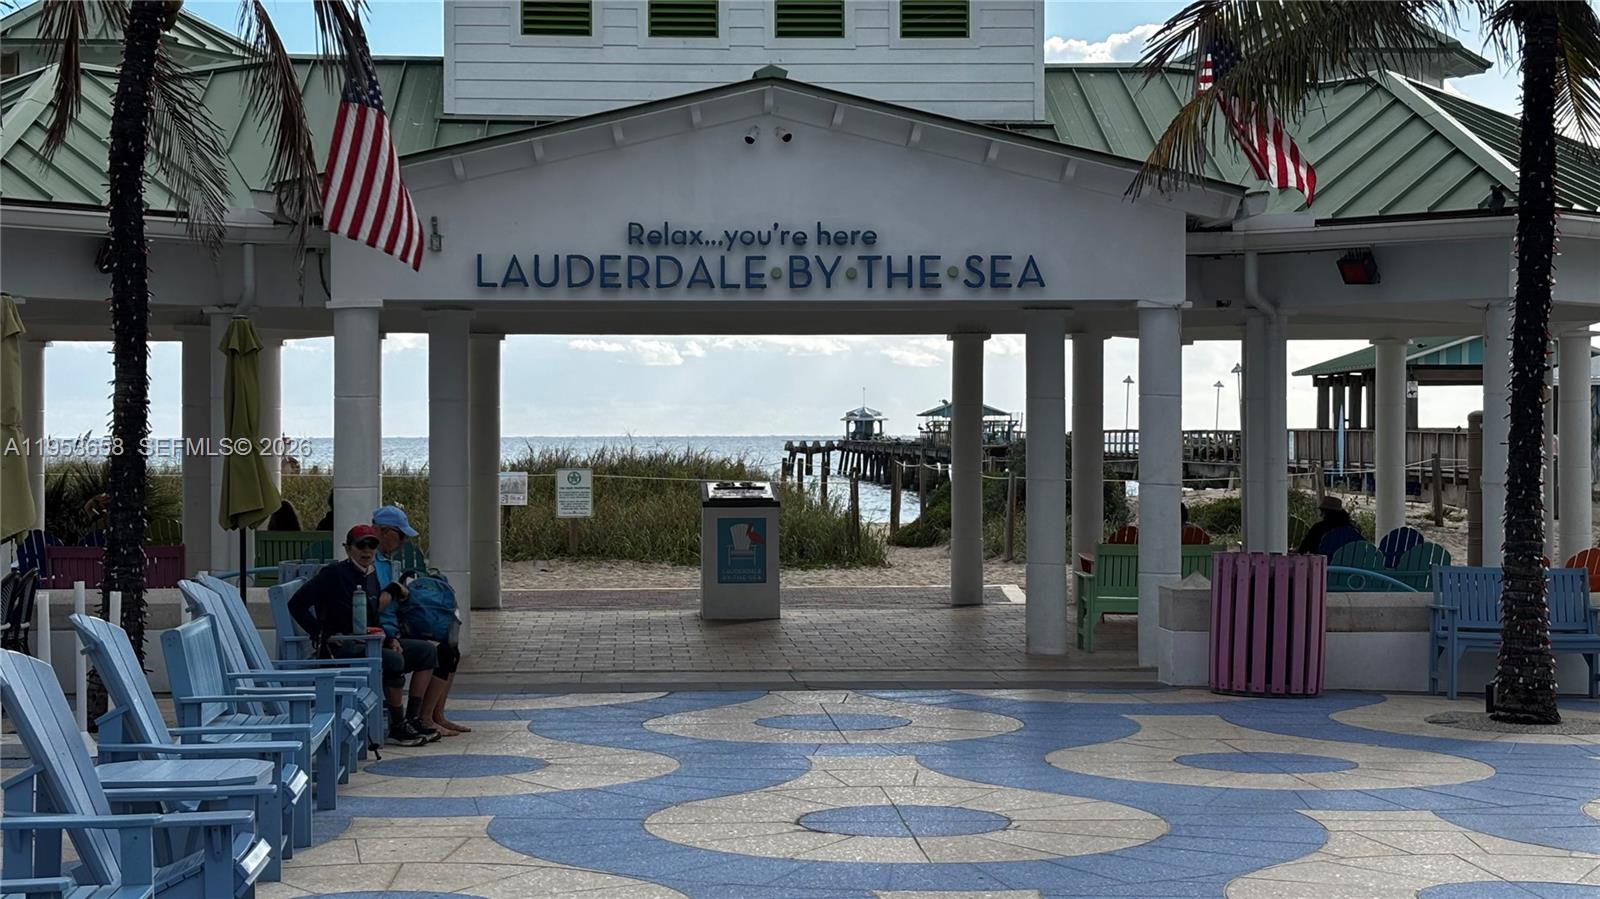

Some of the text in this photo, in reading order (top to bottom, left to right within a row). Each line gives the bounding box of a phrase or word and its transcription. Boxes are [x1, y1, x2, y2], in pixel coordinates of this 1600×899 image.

[627, 221, 878, 251] Relax...you're here
[476, 253, 1046, 289] LAUDERDALE BY THE SEA
